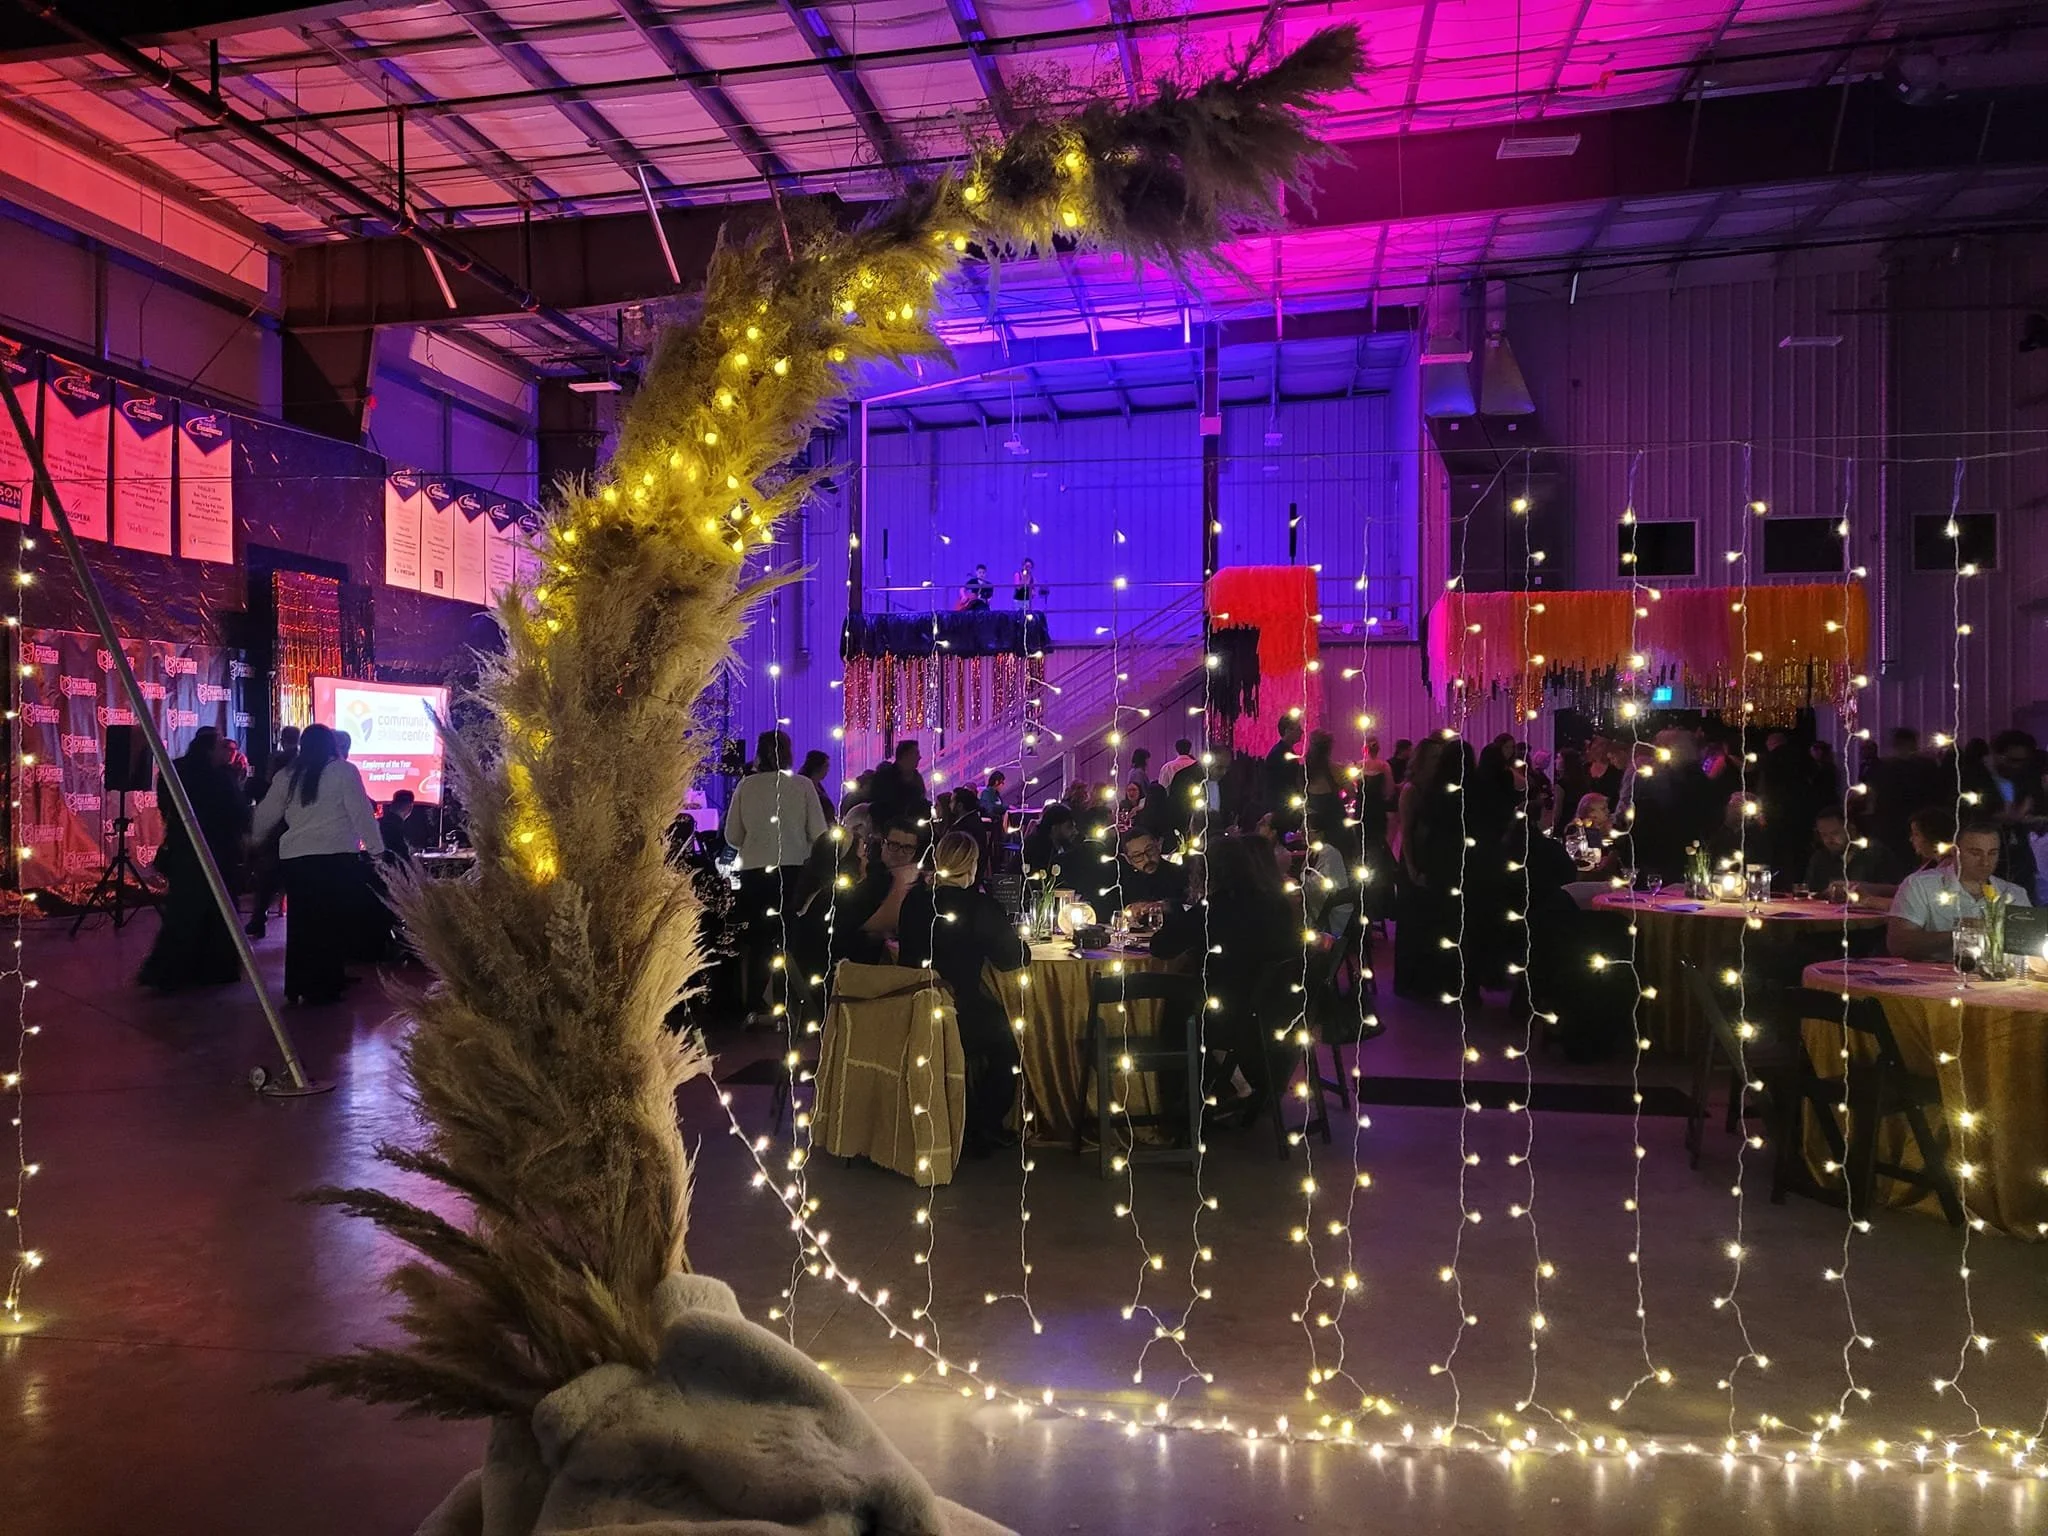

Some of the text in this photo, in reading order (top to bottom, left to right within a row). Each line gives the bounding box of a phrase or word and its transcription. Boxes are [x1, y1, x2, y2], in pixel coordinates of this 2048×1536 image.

[67, 383, 100, 400] Excellence
[133, 406, 163, 420] Excellence
[196, 424, 222, 436] Excellence
[66, 511, 91, 522] ROSPERA
[35, 649, 59, 660] CHAMBER
[176, 660, 198, 670] CHAMBER
[72, 681, 96, 691] CHAMBER
[208, 688, 231, 698] CHAMBER
[35, 708, 60, 718] CHAMBER
[378, 715, 428, 727] community
[36, 768, 63, 778] CHAMBER
[77, 796, 100, 806] CHAMBER
[35, 826, 64, 836] CHAMBER
